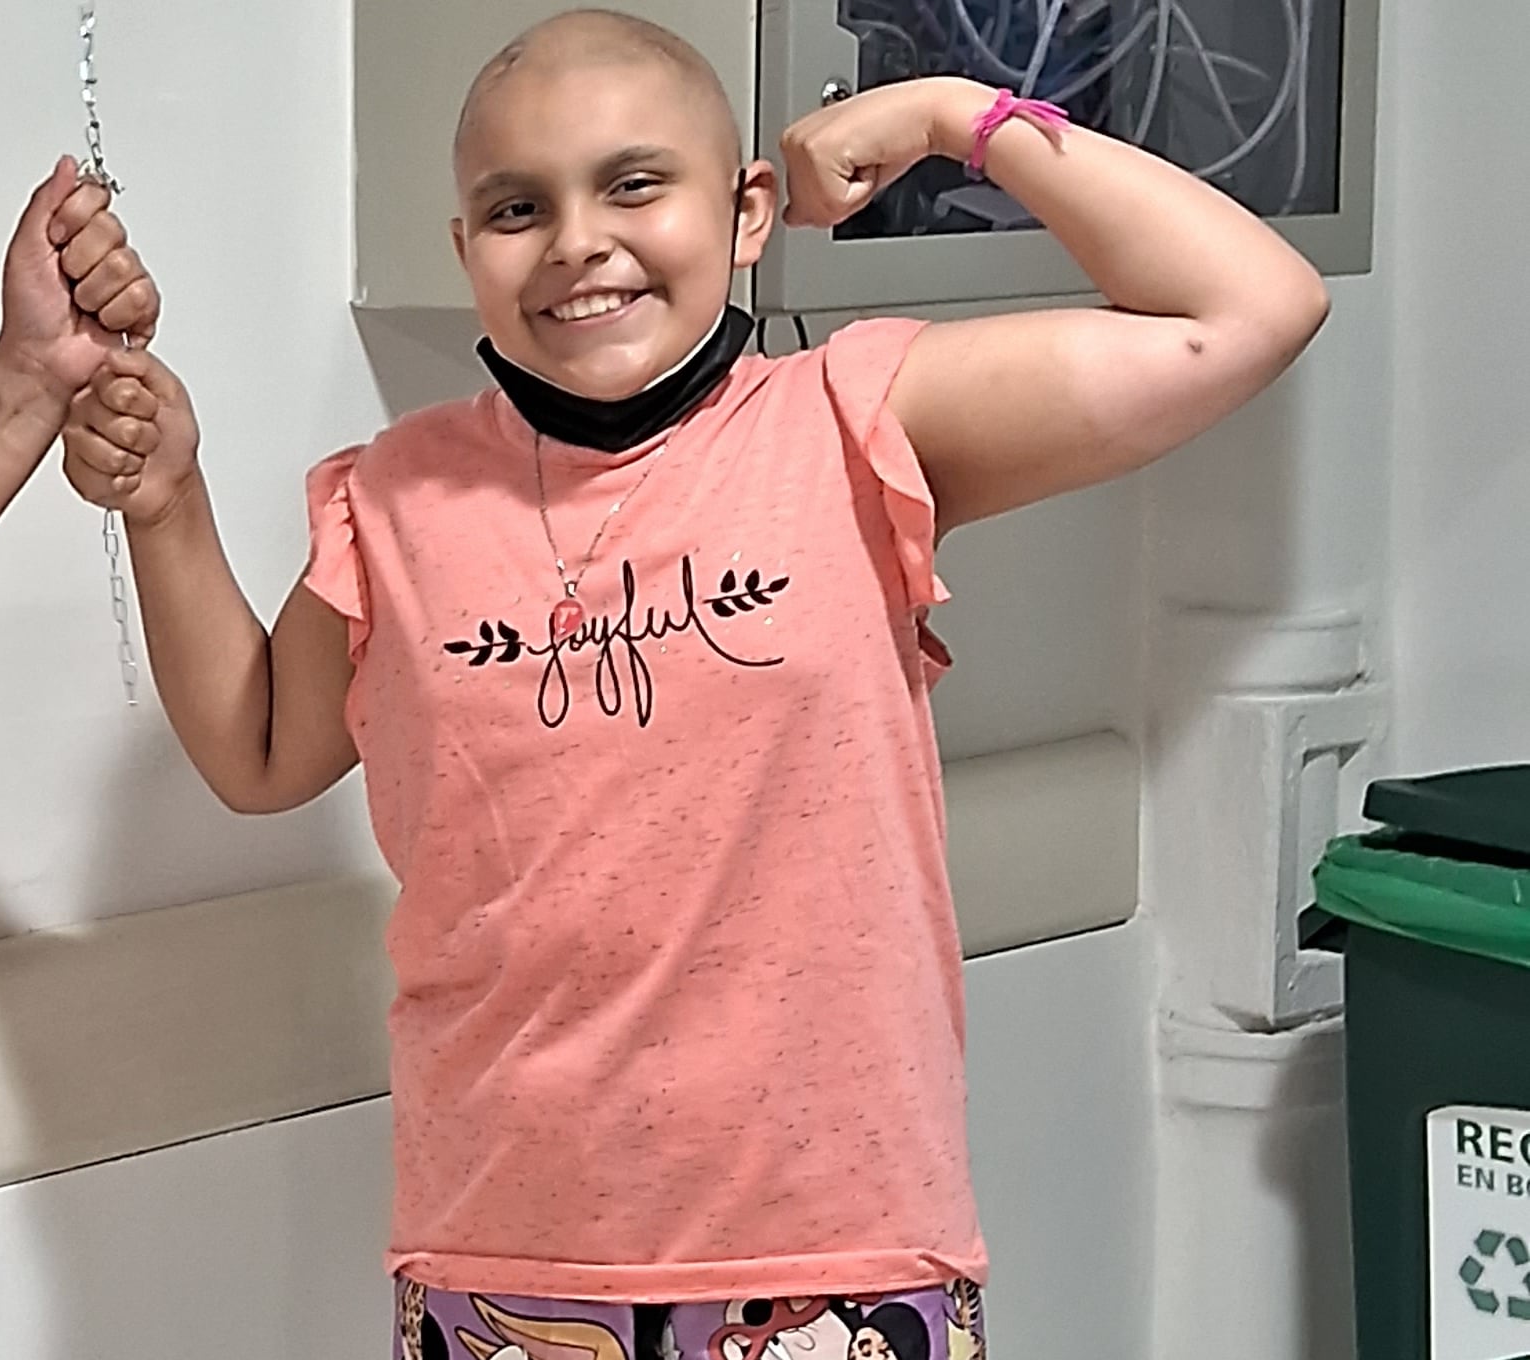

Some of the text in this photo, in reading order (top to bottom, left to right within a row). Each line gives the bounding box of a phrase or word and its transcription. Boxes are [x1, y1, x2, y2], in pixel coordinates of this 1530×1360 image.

[526, 554, 784, 729] joyful
[1457, 1163, 1530, 1198] EN B
